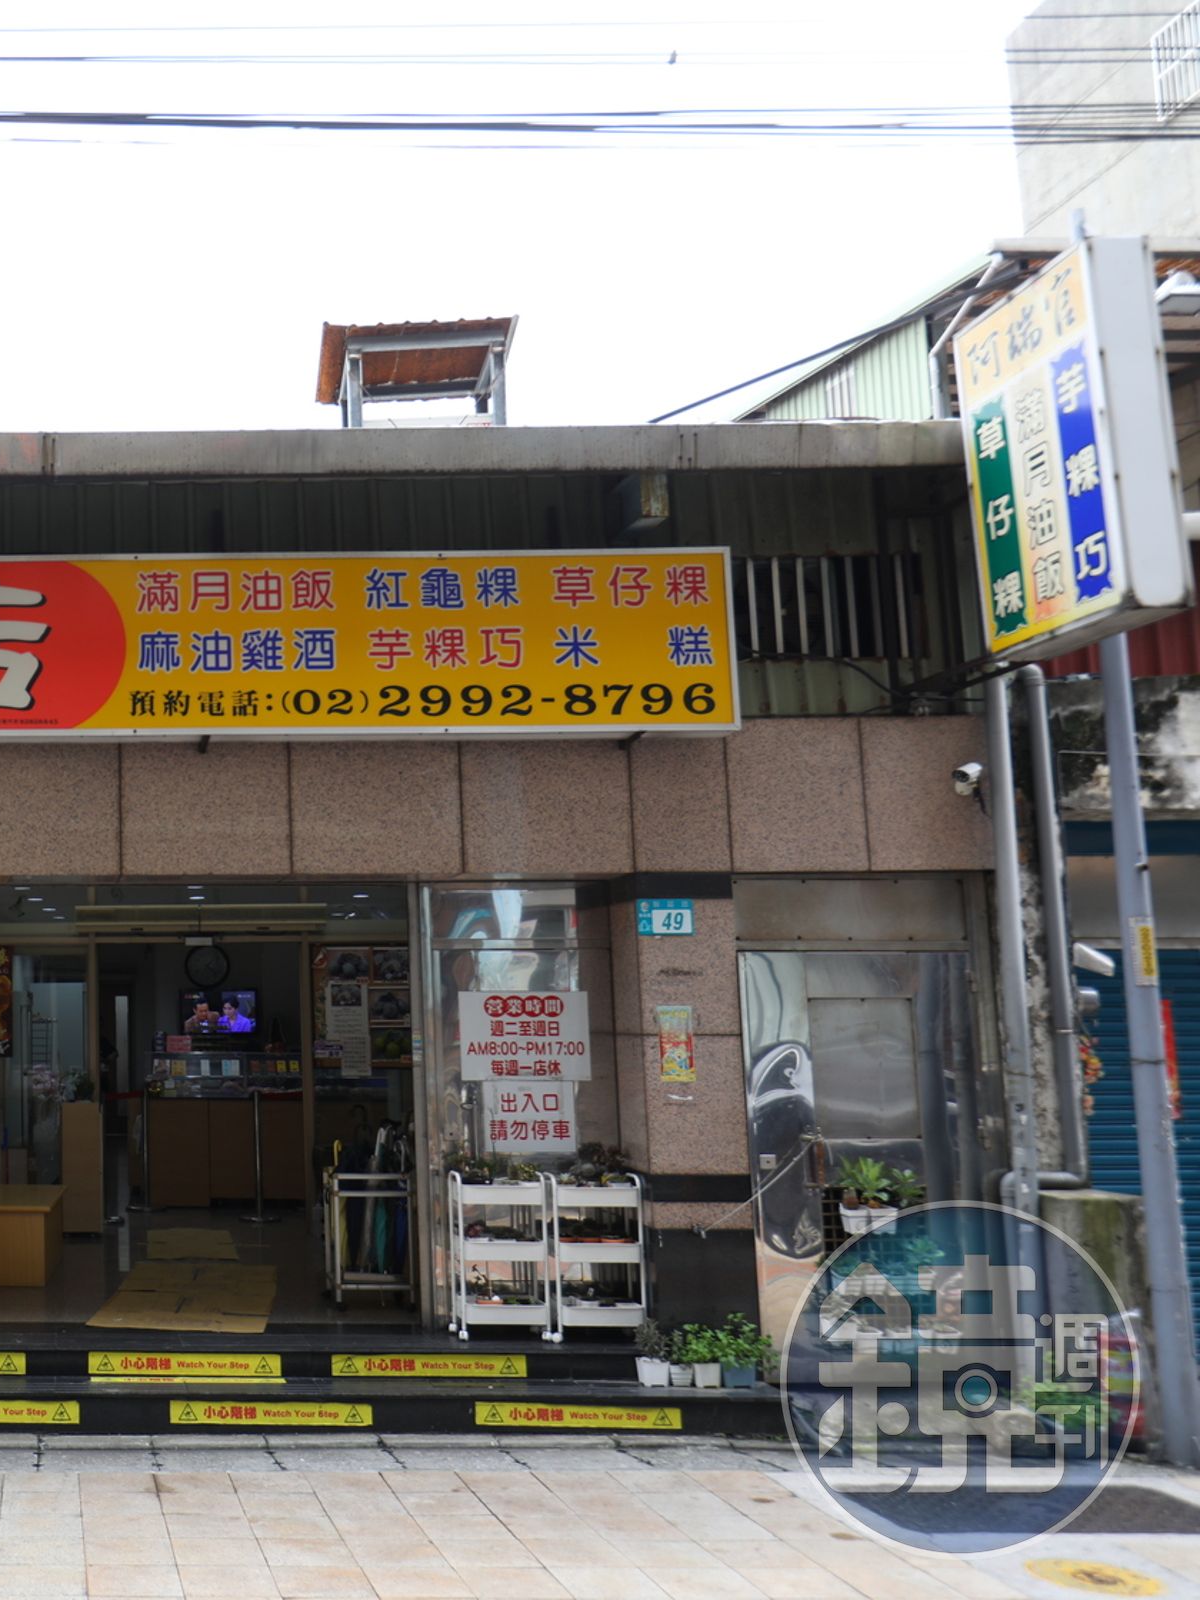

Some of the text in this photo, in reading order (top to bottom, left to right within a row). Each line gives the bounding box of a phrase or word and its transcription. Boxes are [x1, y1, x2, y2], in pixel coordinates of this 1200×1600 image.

[1055, 362, 1107, 580] 芋粿巧
[1015, 388, 1064, 604] 滿月油飯
[976, 416, 1024, 619] 草仔粿
[136, 565, 709, 612] 滿月油飯 紅龜粿 草仔粿
[138, 629, 336, 672] 麻油雞酒
[367, 627, 523, 670] 芋粿巧
[662, 912, 684, 930] 49
[484, 997, 562, 1015] 營業時間
[490, 1020, 560, 1037] 週二至週日
[467, 1041, 585, 1056] AM8:00~PM17:00
[490, 1060, 561, 1076] 每週一店休
[500, 1092, 560, 1113] 出入口
[489, 1120, 571, 1141] 請勿停車
[120, 1357, 249, 1370] 小心階梯 Watch Your Step
[363, 1359, 495, 1372] 小心階梯 Watch Your Step
[3, 1408, 23, 1416] Your
[26, 1407, 47, 1417] Step
[203, 1405, 339, 1419] 小心階梯 Watch Your Step
[509, 1408, 648, 1422] 小心階梯 Watch Your Step
